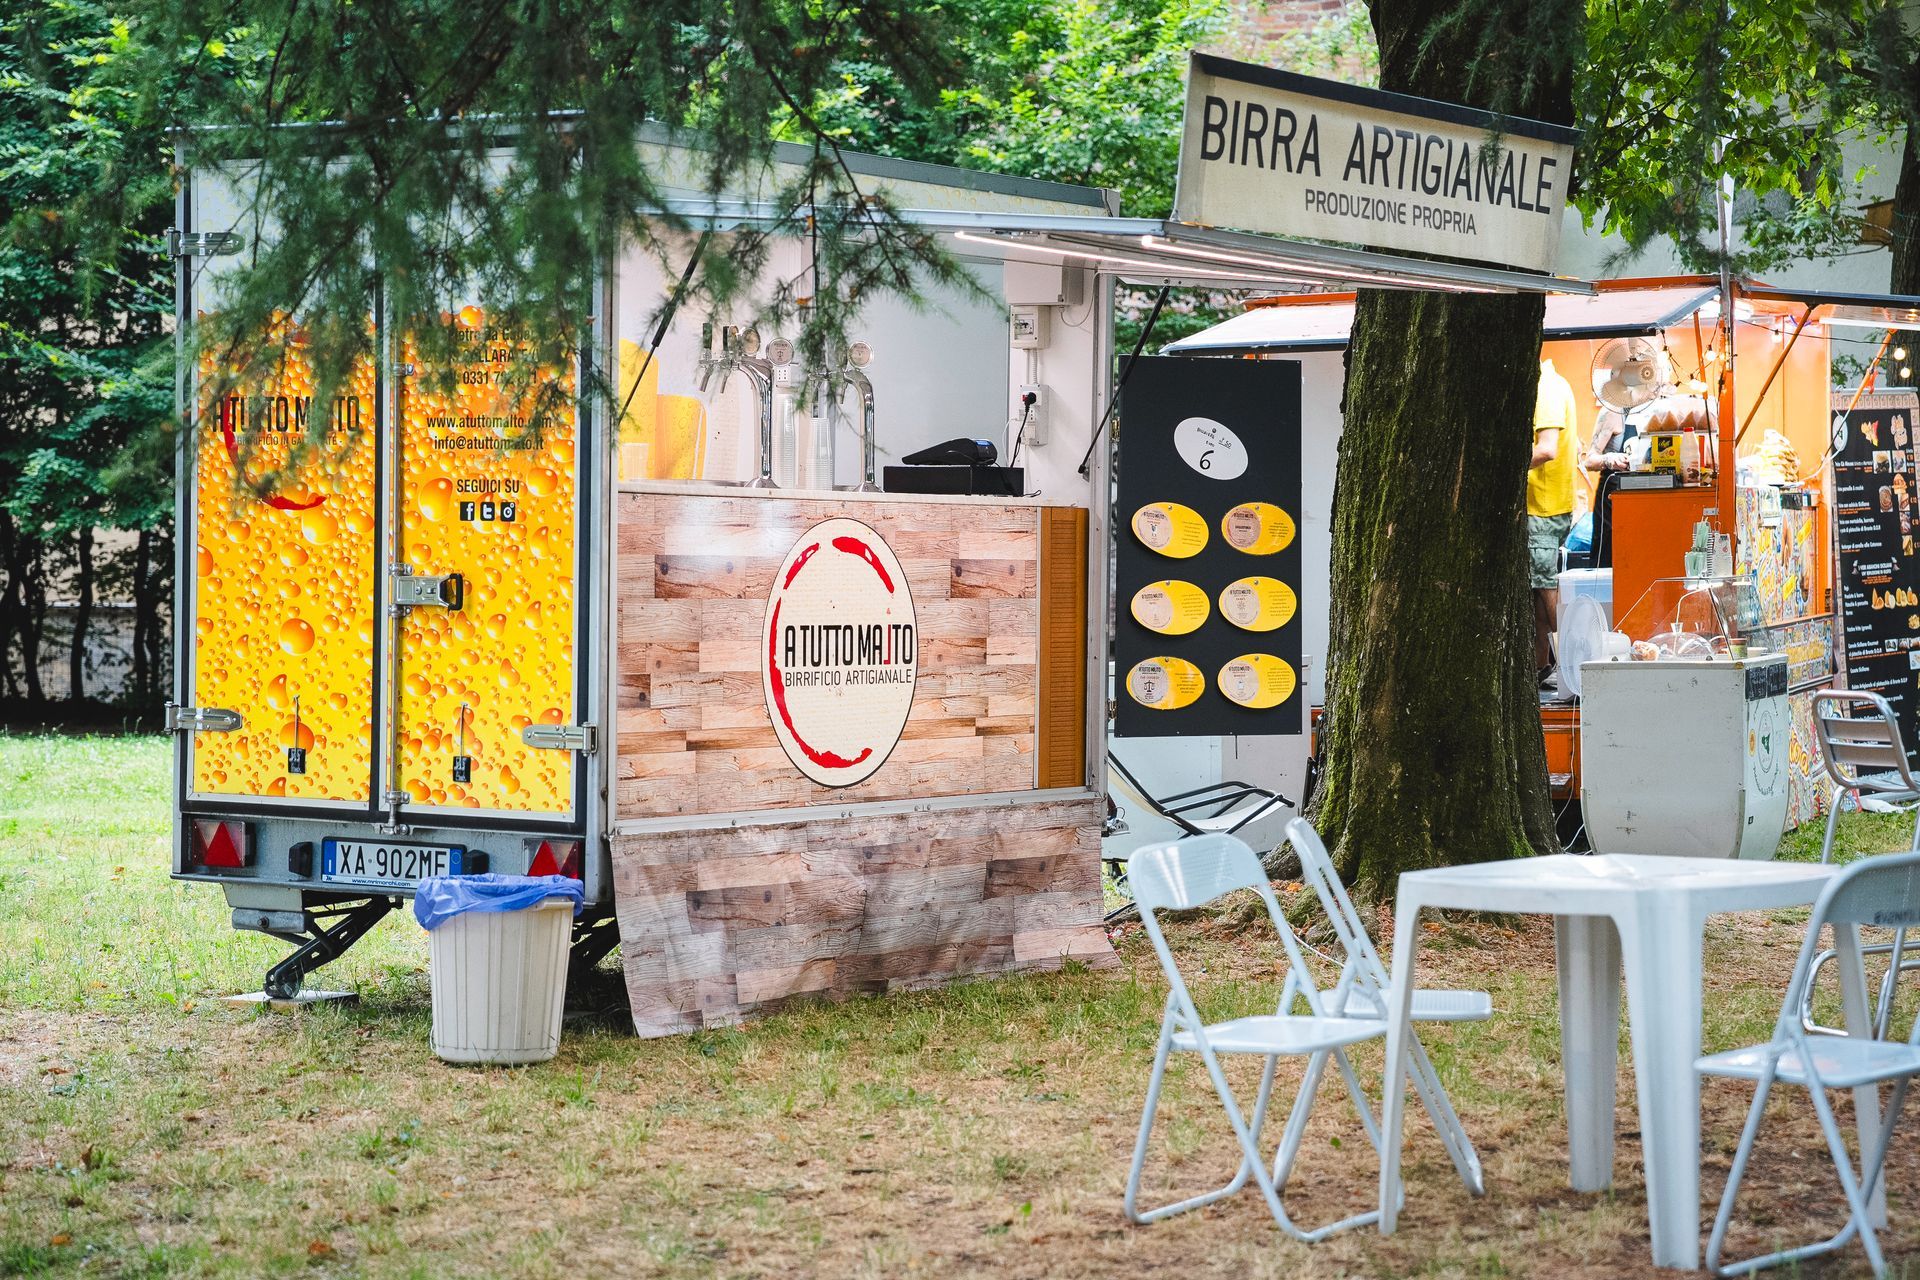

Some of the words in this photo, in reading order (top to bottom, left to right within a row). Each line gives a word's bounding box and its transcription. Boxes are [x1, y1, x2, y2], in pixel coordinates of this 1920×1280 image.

[1200, 95, 1321, 178] BIRRA
[1343, 121, 1557, 215] ARTIGIANALE
[1305, 188, 1407, 225] PRODUZIONE
[1413, 204, 1477, 236] PROPRIA
[463, 370, 489, 385] 0331
[1200, 450, 1214, 470] 6
[456, 479, 501, 493] SEGUICI
[504, 479, 520, 493] SU
[785, 625, 796, 667] A
[800, 625, 853, 667] TUTTO
[785, 669, 841, 687] BIRRIFICIO
[845, 668, 912, 685] ARTIGIANALE
